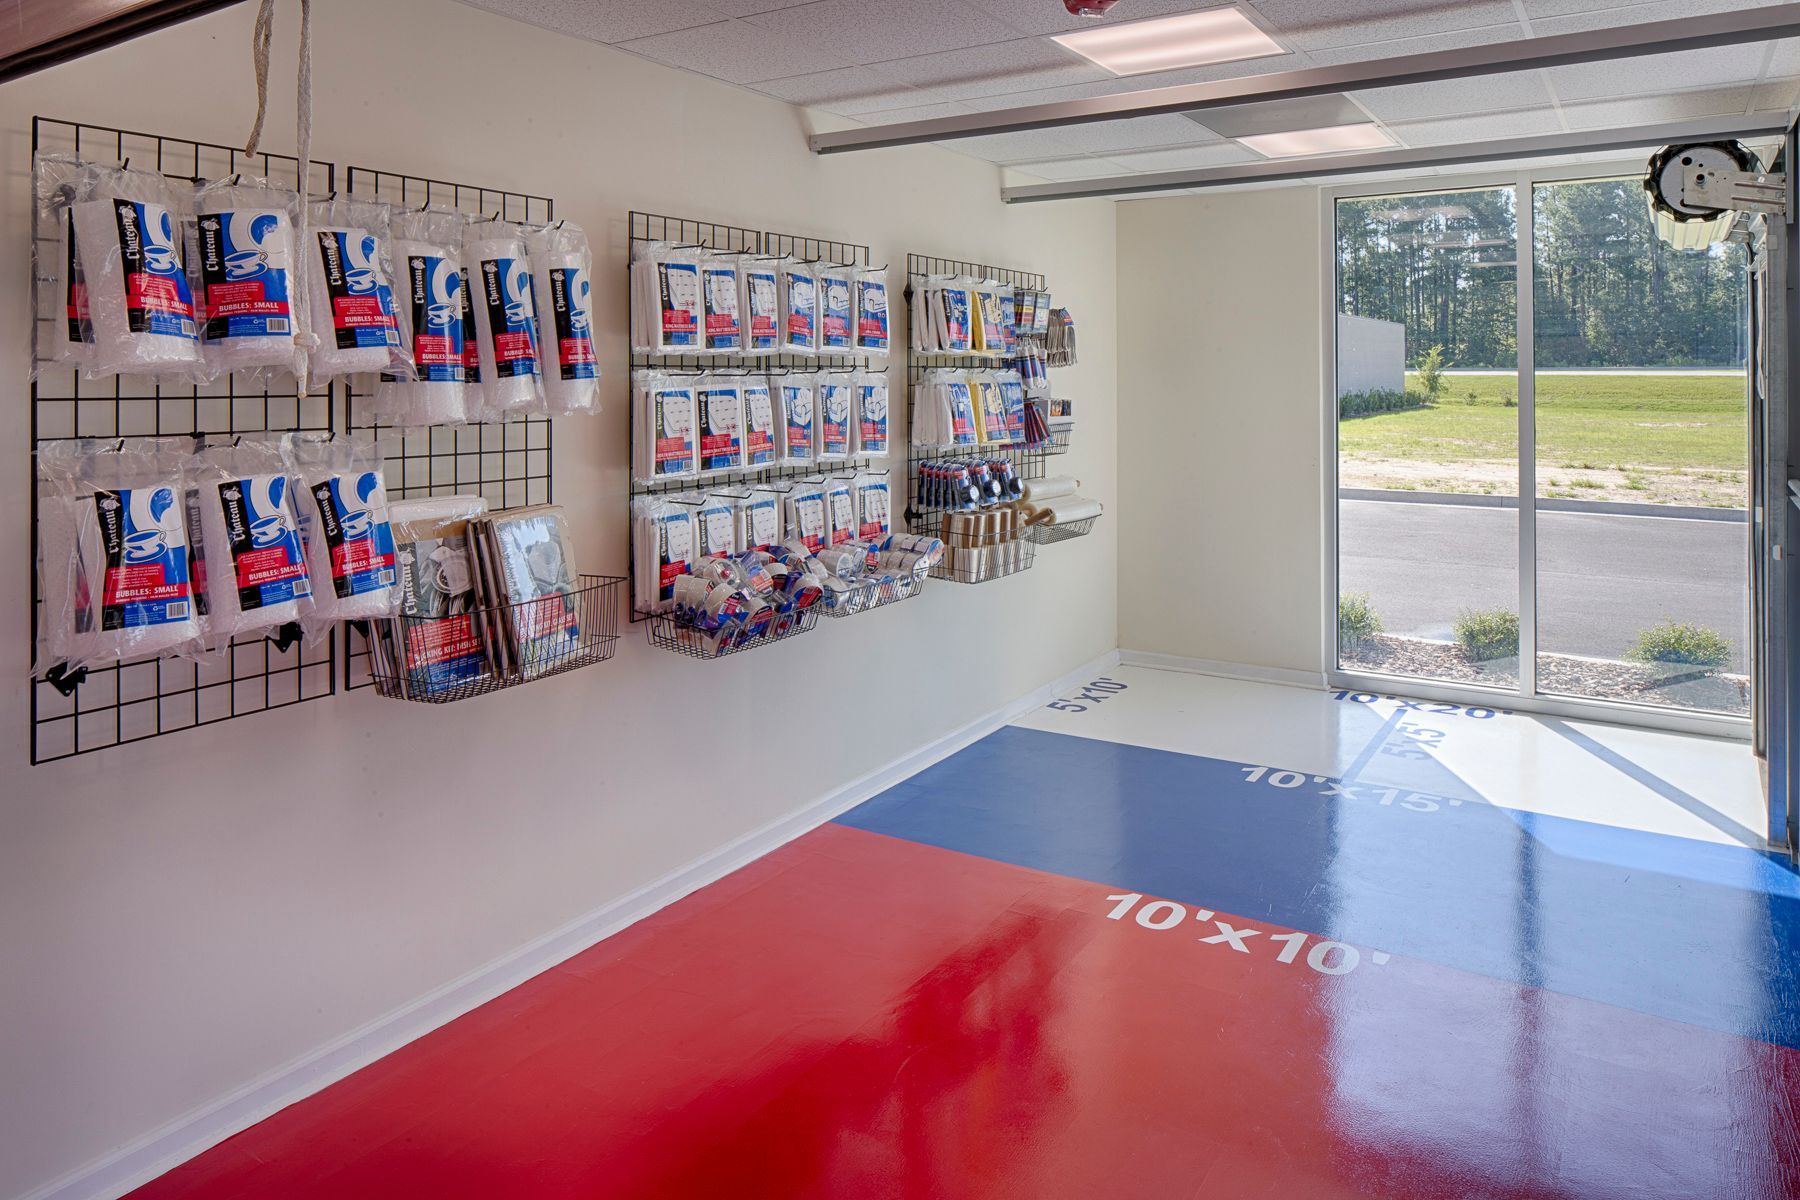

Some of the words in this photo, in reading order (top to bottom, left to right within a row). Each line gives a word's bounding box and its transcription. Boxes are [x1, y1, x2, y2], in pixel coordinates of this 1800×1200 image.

[125, 219, 139, 260] Chateau
[206, 231, 219, 271] Chateau
[327, 248, 342, 286] Chateau
[414, 269, 425, 304] Chateau
[486, 272, 500, 306] Chateau
[556, 282, 566, 312] Chateau
[219, 303, 252, 312] BUBBLES:
[106, 510, 120, 553] Chateau
[229, 500, 245, 541] Chateau
[321, 500, 338, 536] Chateau
[115, 588, 152, 598] BUBBLES:
[154, 586, 179, 594] SMALL
[249, 570, 279, 581] BUBBLES:
[403, 562, 418, 615] Chateau
